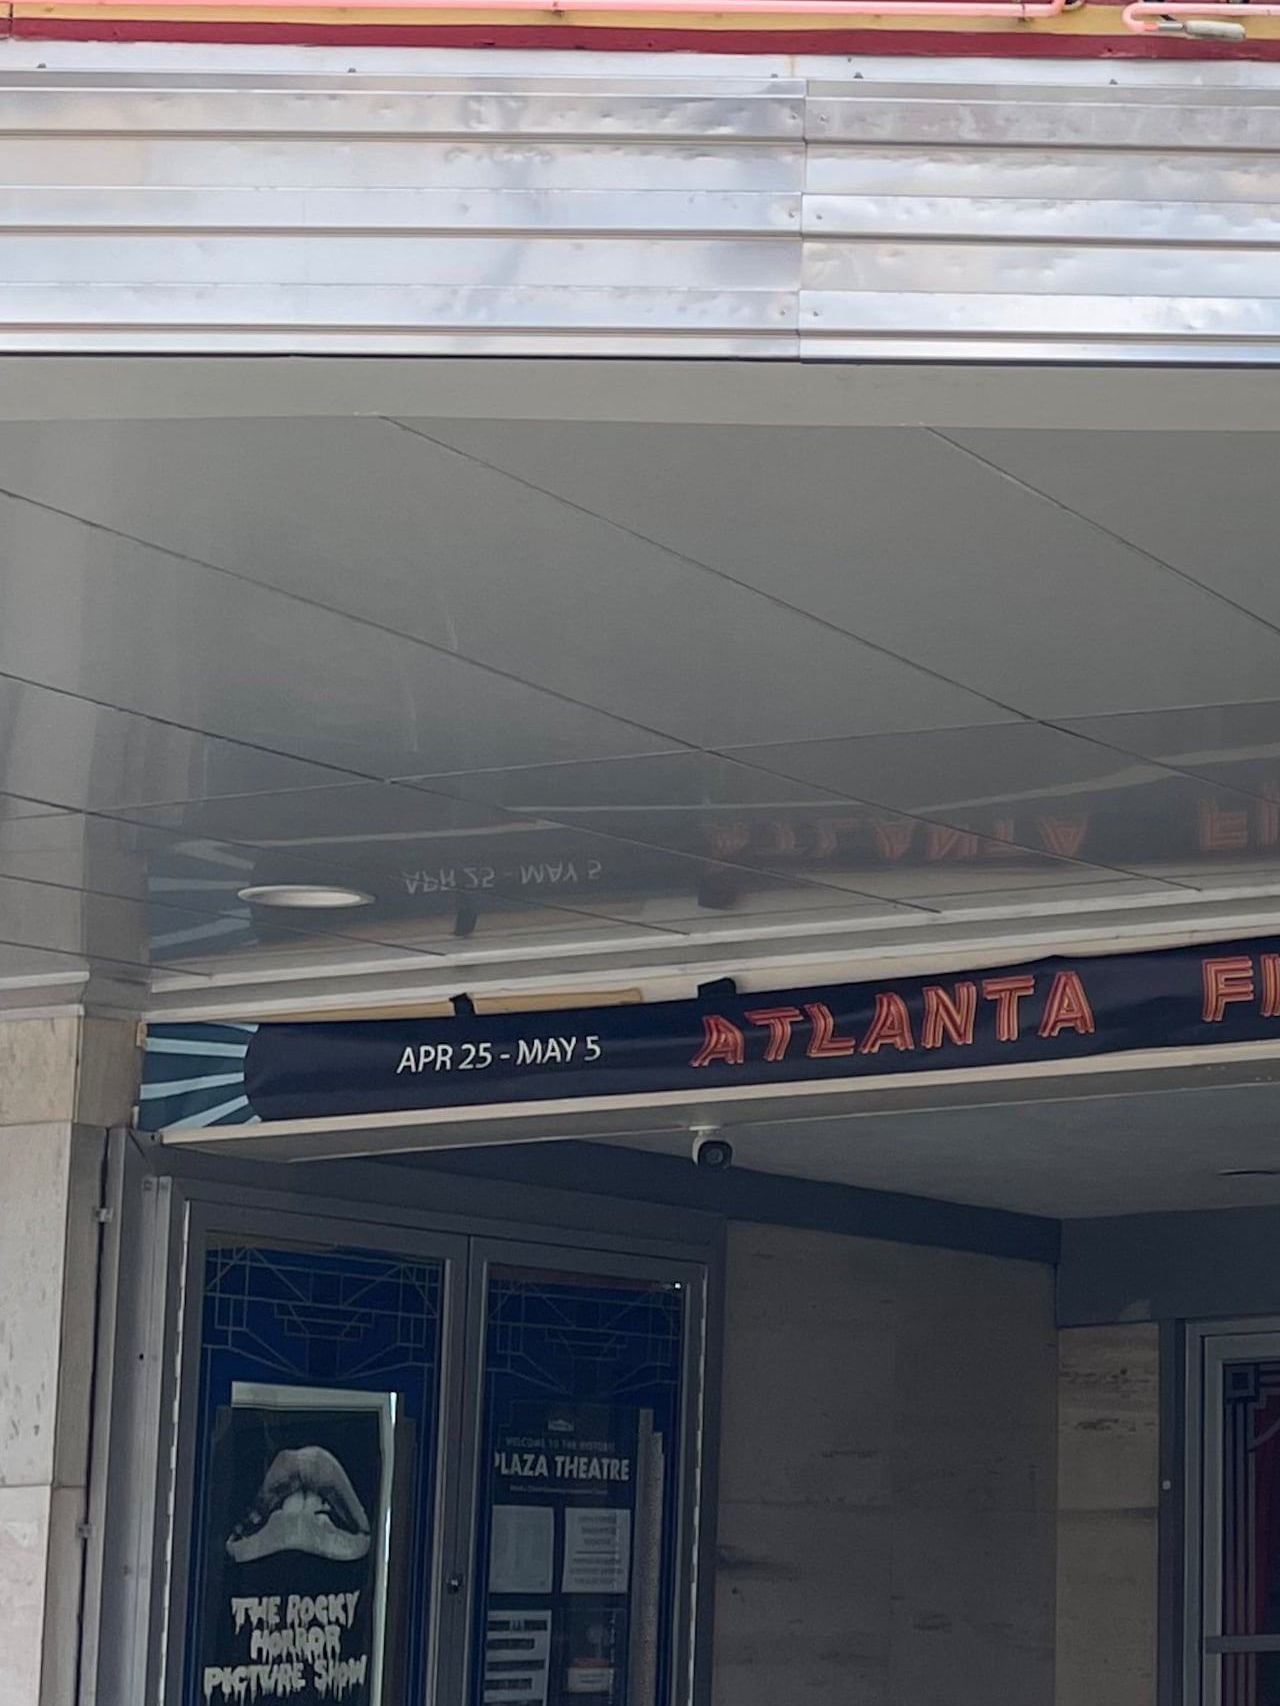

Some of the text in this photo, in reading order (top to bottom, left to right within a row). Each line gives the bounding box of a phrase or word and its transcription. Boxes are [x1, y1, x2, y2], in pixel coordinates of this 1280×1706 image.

[690, 969, 1095, 1070] ATLANTA
[397, 1040, 454, 1075] APR
[459, 1040, 492, 1071] 25
[516, 1037, 580, 1067] MAY
[586, 1035, 602, 1063] 5
[554, 1455, 631, 1482] THEATRE
[231, 1589, 361, 1635] THE ROCKY
[250, 1623, 341, 1666] HORROR
[313, 1654, 367, 1702] SHOW
